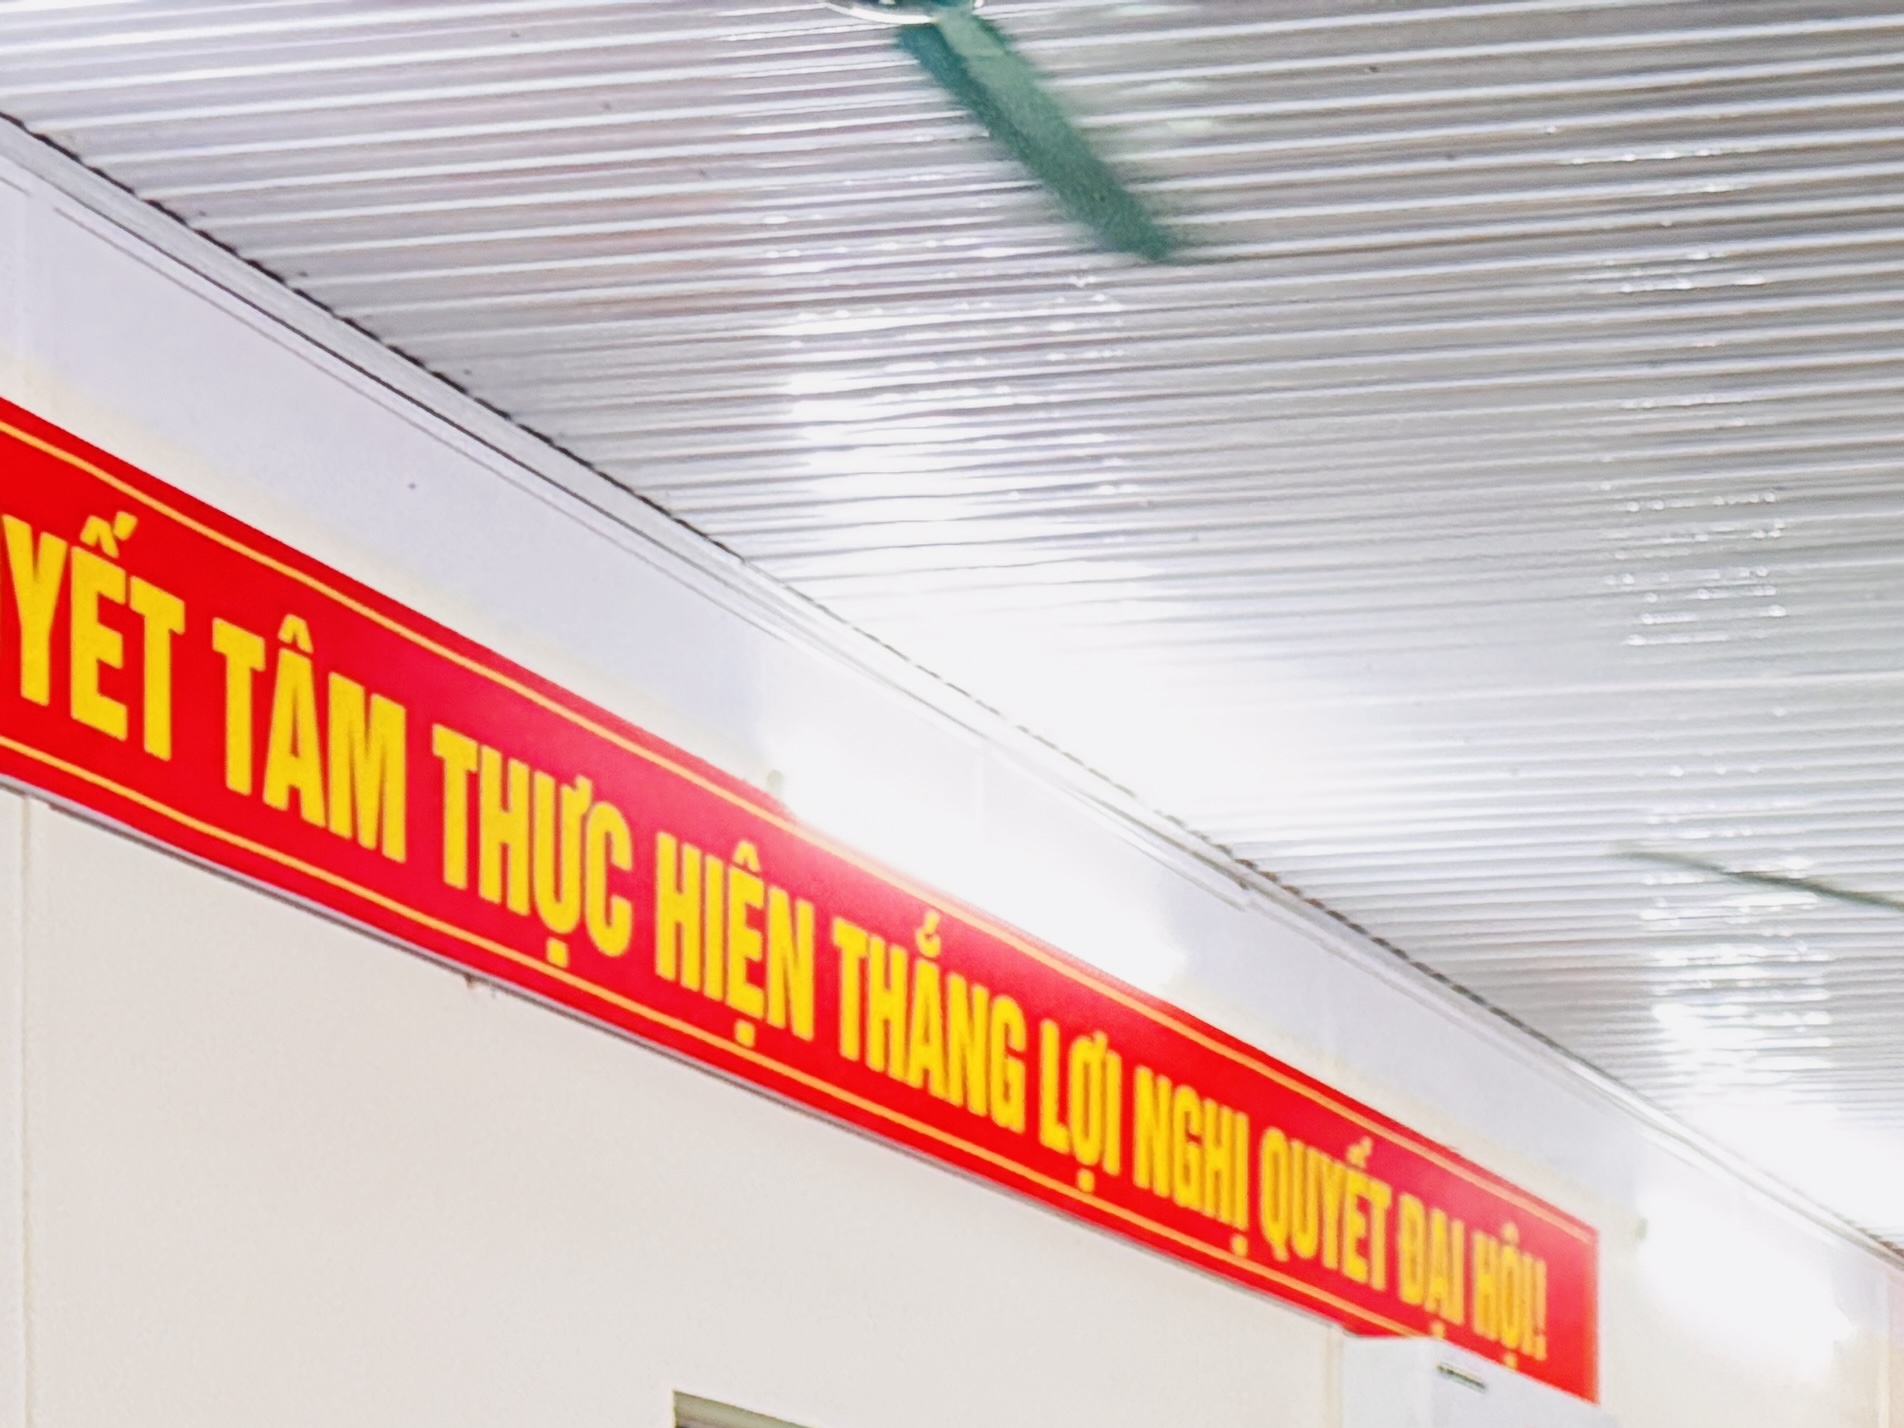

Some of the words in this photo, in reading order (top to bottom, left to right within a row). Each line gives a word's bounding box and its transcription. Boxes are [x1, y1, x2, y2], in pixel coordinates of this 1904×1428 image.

[2, 511, 187, 763] YẾT
[211, 613, 407, 864] TÂM
[431, 722, 634, 969] THỰC
[655, 830, 816, 1048] HIỆN
[831, 909, 1028, 1134] THẮNG
[1039, 1017, 1122, 1193] LỢI
[1133, 1065, 1250, 1257] NGHỊ
[1259, 1125, 1393, 1292] QUYẾT
[1398, 1191, 1467, 1340] ĐẠI
